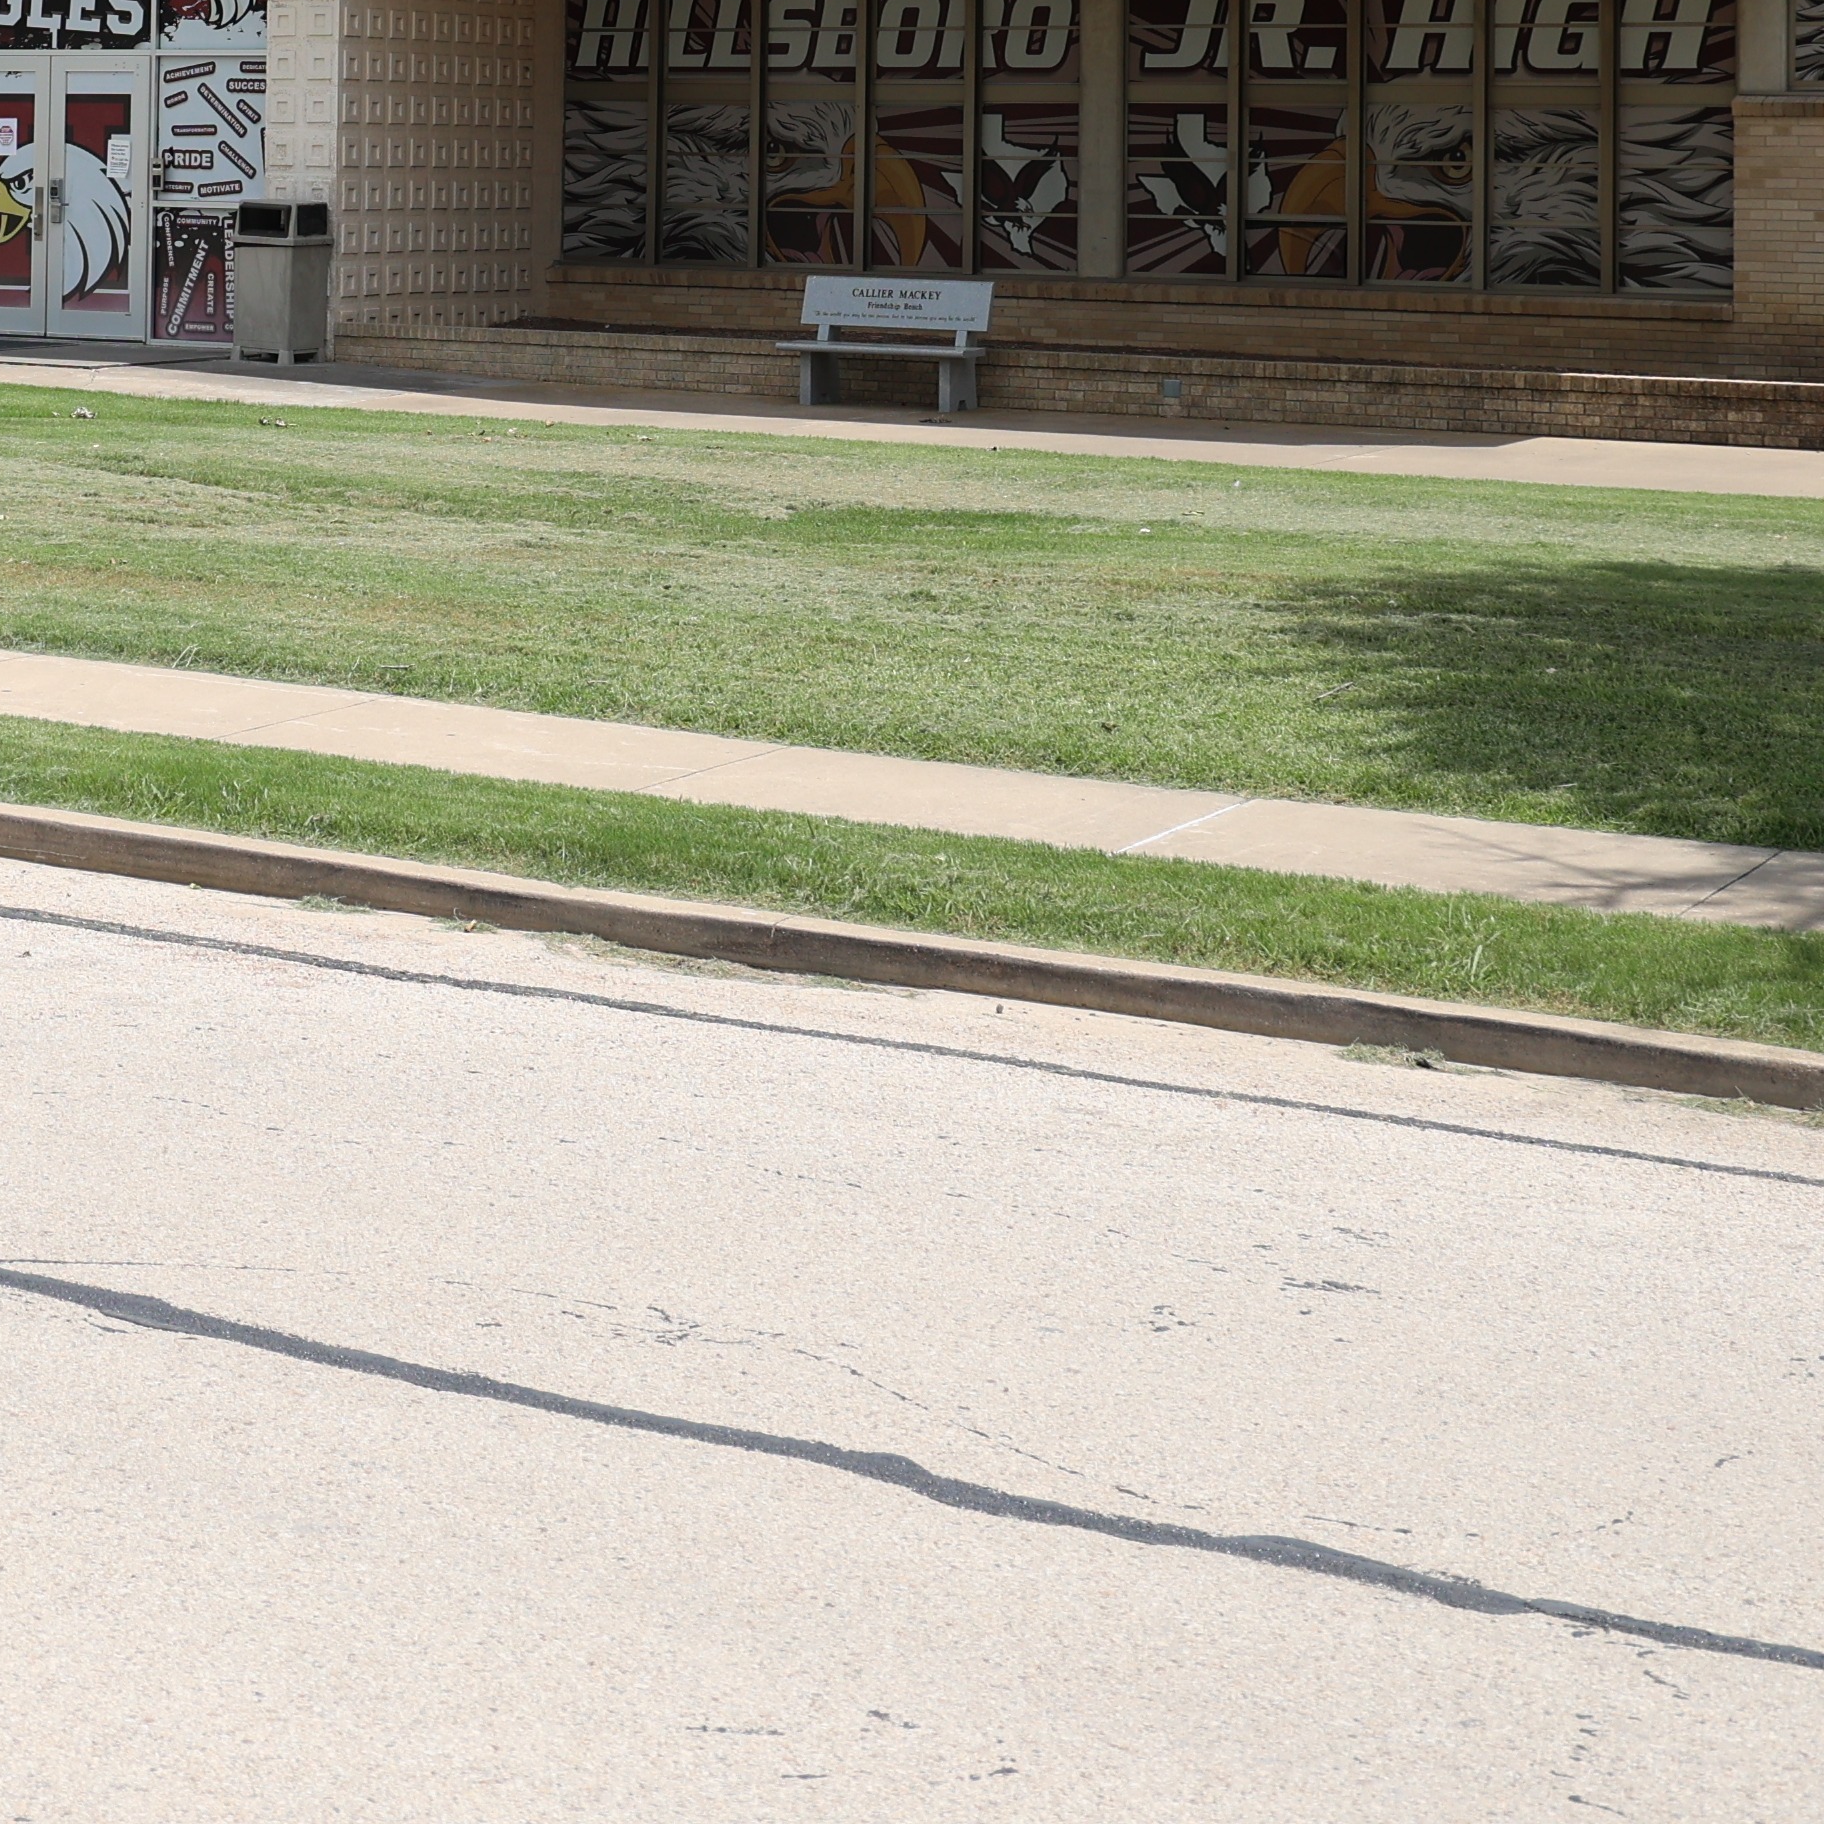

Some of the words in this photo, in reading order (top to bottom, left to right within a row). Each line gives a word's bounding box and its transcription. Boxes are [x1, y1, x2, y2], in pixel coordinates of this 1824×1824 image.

[165, 64, 214, 80] ACHIEVEMENT
[228, 81, 266, 91] SUCCES
[199, 85, 245, 136] DETERMINATION
[238, 101, 259, 122] SPIRIT
[164, 152, 212, 167] PRIDE
[220, 142, 255, 177] CHALLENGE
[200, 183, 241, 194] MOTIVATE
[164, 217, 175, 267] CONFIDENCE
[223, 219, 235, 319] LEADERSHIP
[161, 277, 169, 315] PURPOSE
[167, 239, 209, 334] COMMITMENT
[852, 288, 894, 299] CALLIER
[899, 290, 941, 300] MACKEY
[868, 301, 900, 311] Friendship
[904, 303, 923, 311] Bench
